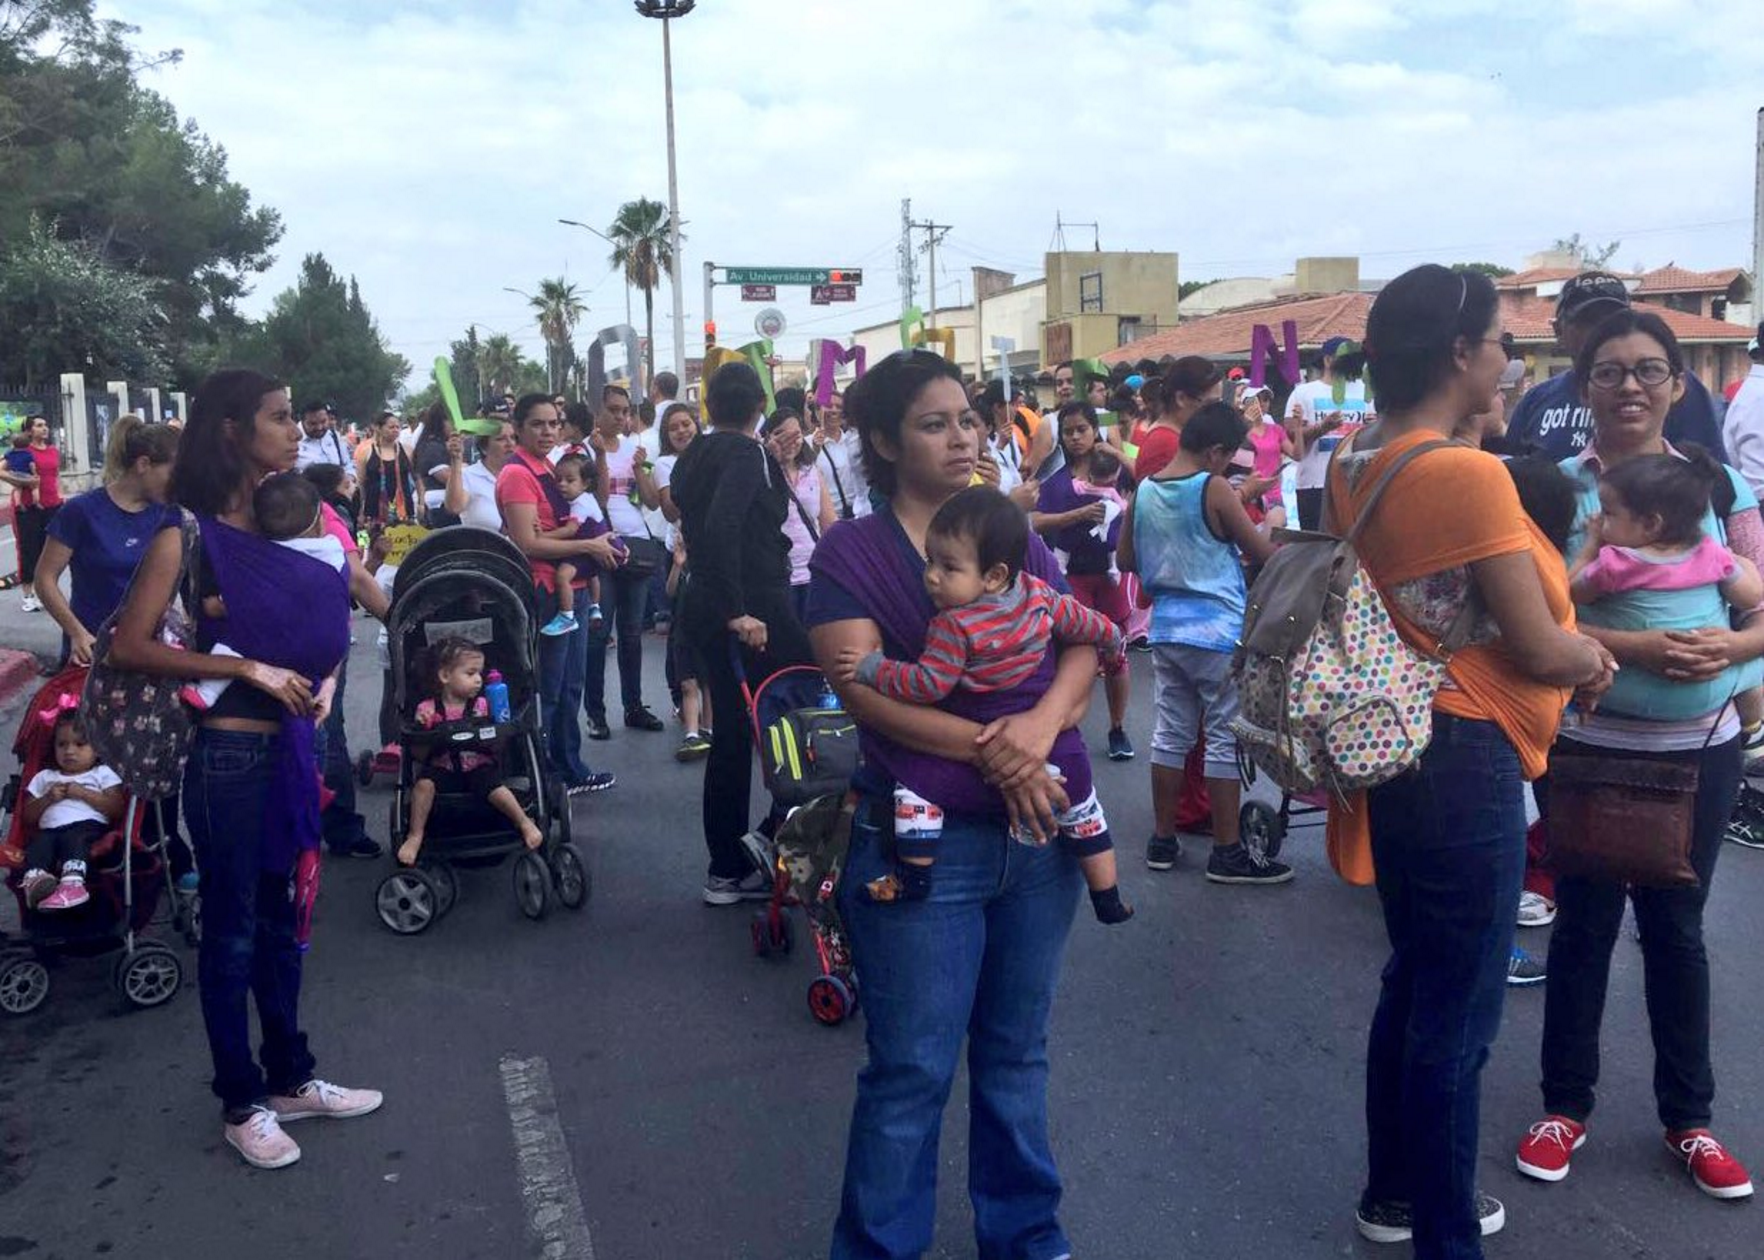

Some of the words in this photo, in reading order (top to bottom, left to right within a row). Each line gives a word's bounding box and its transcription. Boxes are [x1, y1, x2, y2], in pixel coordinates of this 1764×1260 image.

[729, 271, 743, 281] Av.
[749, 270, 812, 282] Universidad
[816, 338, 866, 408] M
[1251, 319, 1300, 388] N
[434, 356, 502, 436] L
[1539, 403, 1570, 436] got
